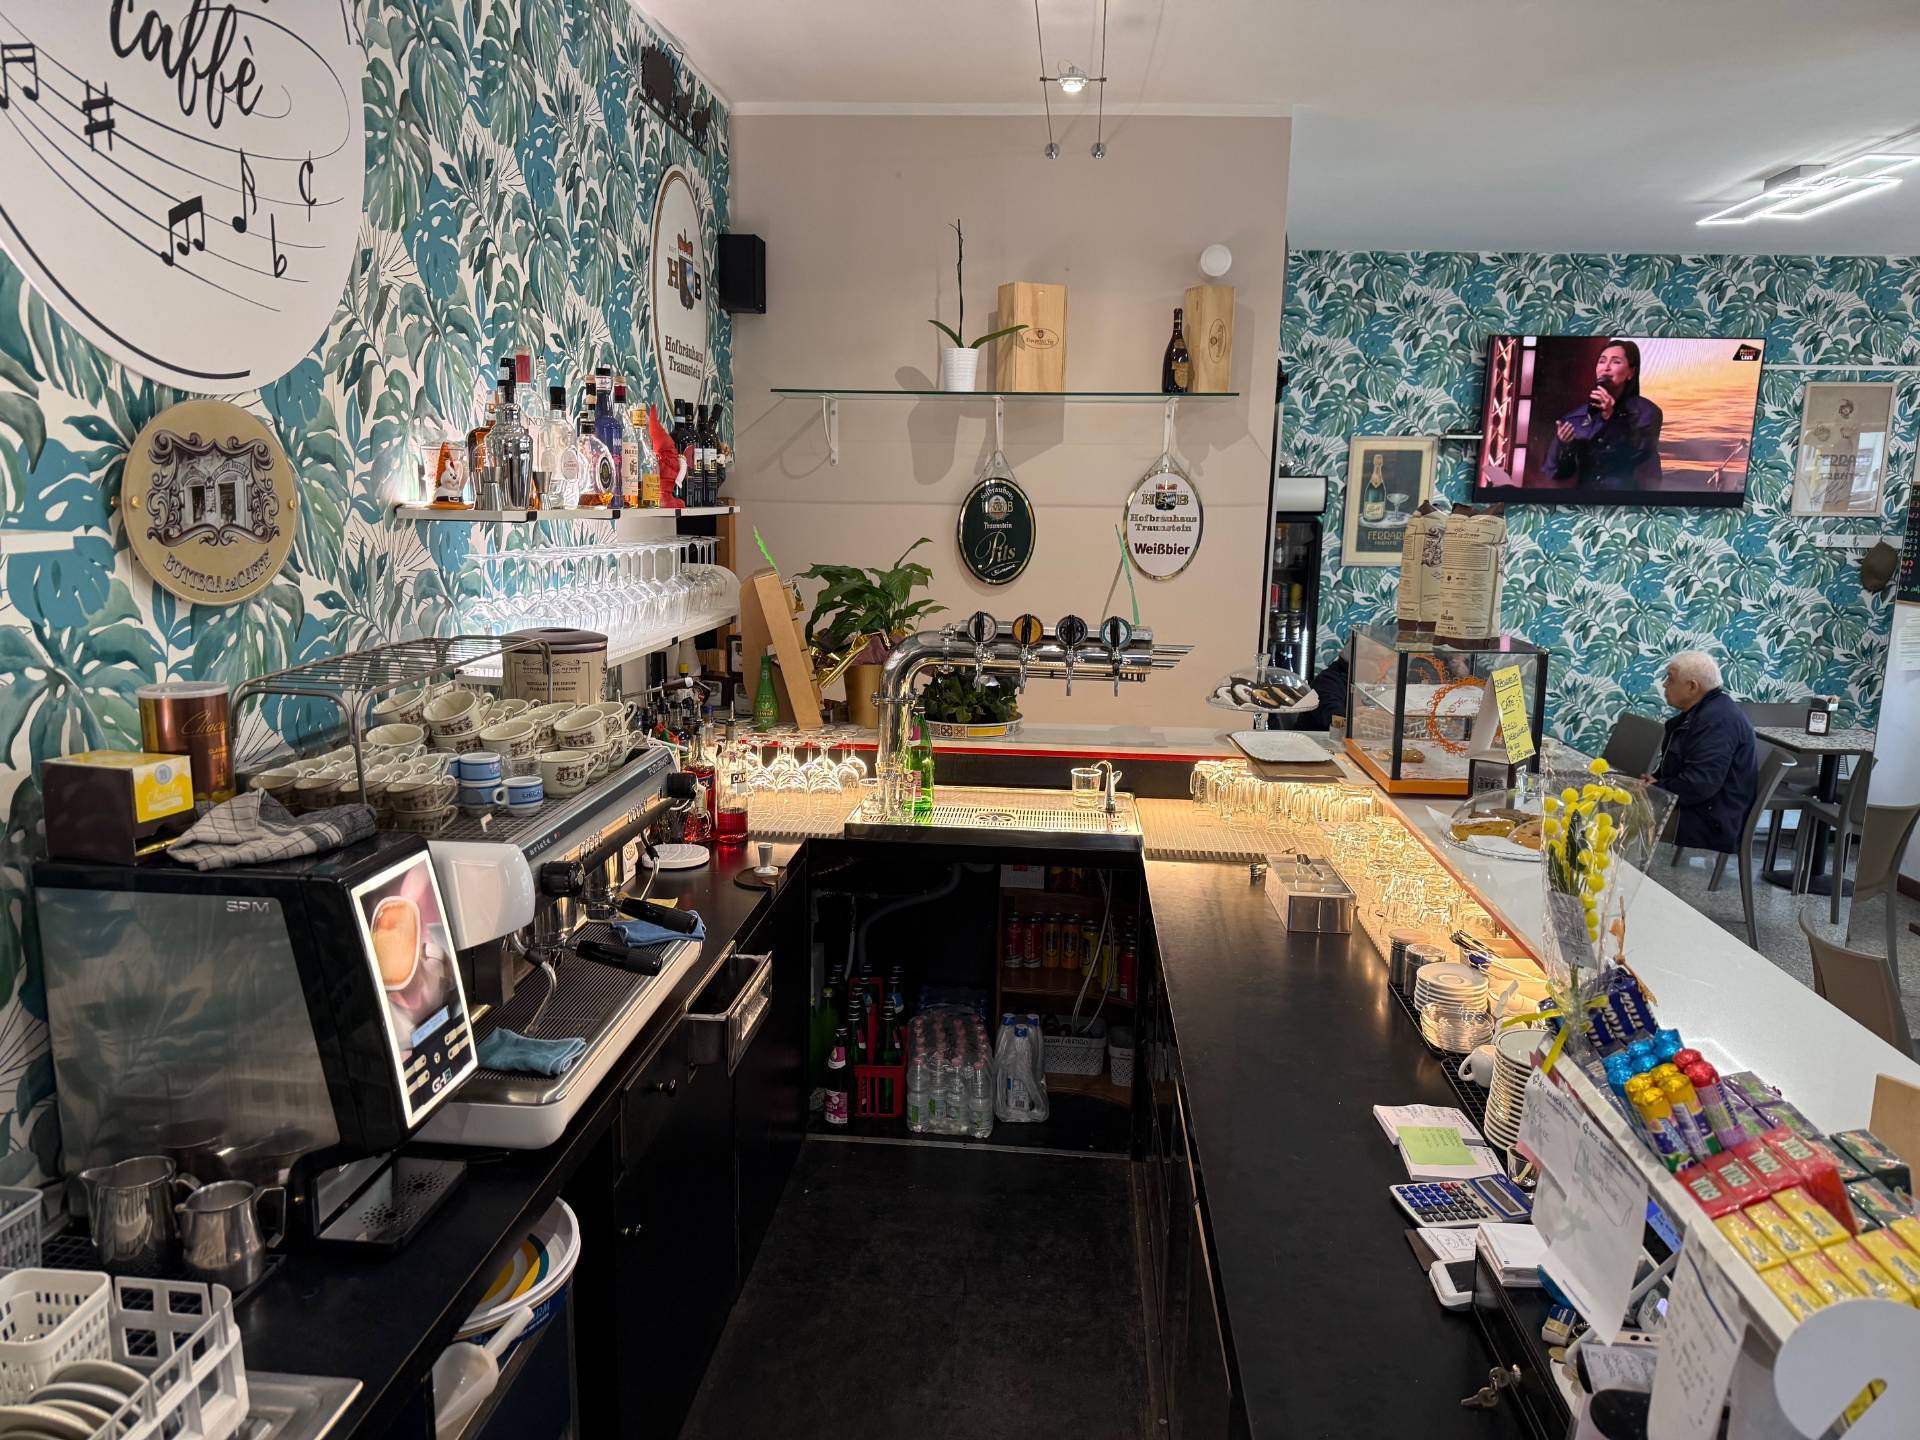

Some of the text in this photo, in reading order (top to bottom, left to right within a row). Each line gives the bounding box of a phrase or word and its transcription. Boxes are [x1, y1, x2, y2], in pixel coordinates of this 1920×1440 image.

[110, 0, 264, 129] Caffè
[668, 355, 701, 380] Traunstein
[1135, 523, 1192, 532] Traunstein
[1134, 542, 1190, 555] Weißbier
[163, 552, 223, 593] BOTTEGA
[529, 839, 552, 856] ariete
[226, 901, 270, 912] SPM
[1716, 1084, 1740, 1126] mentos
